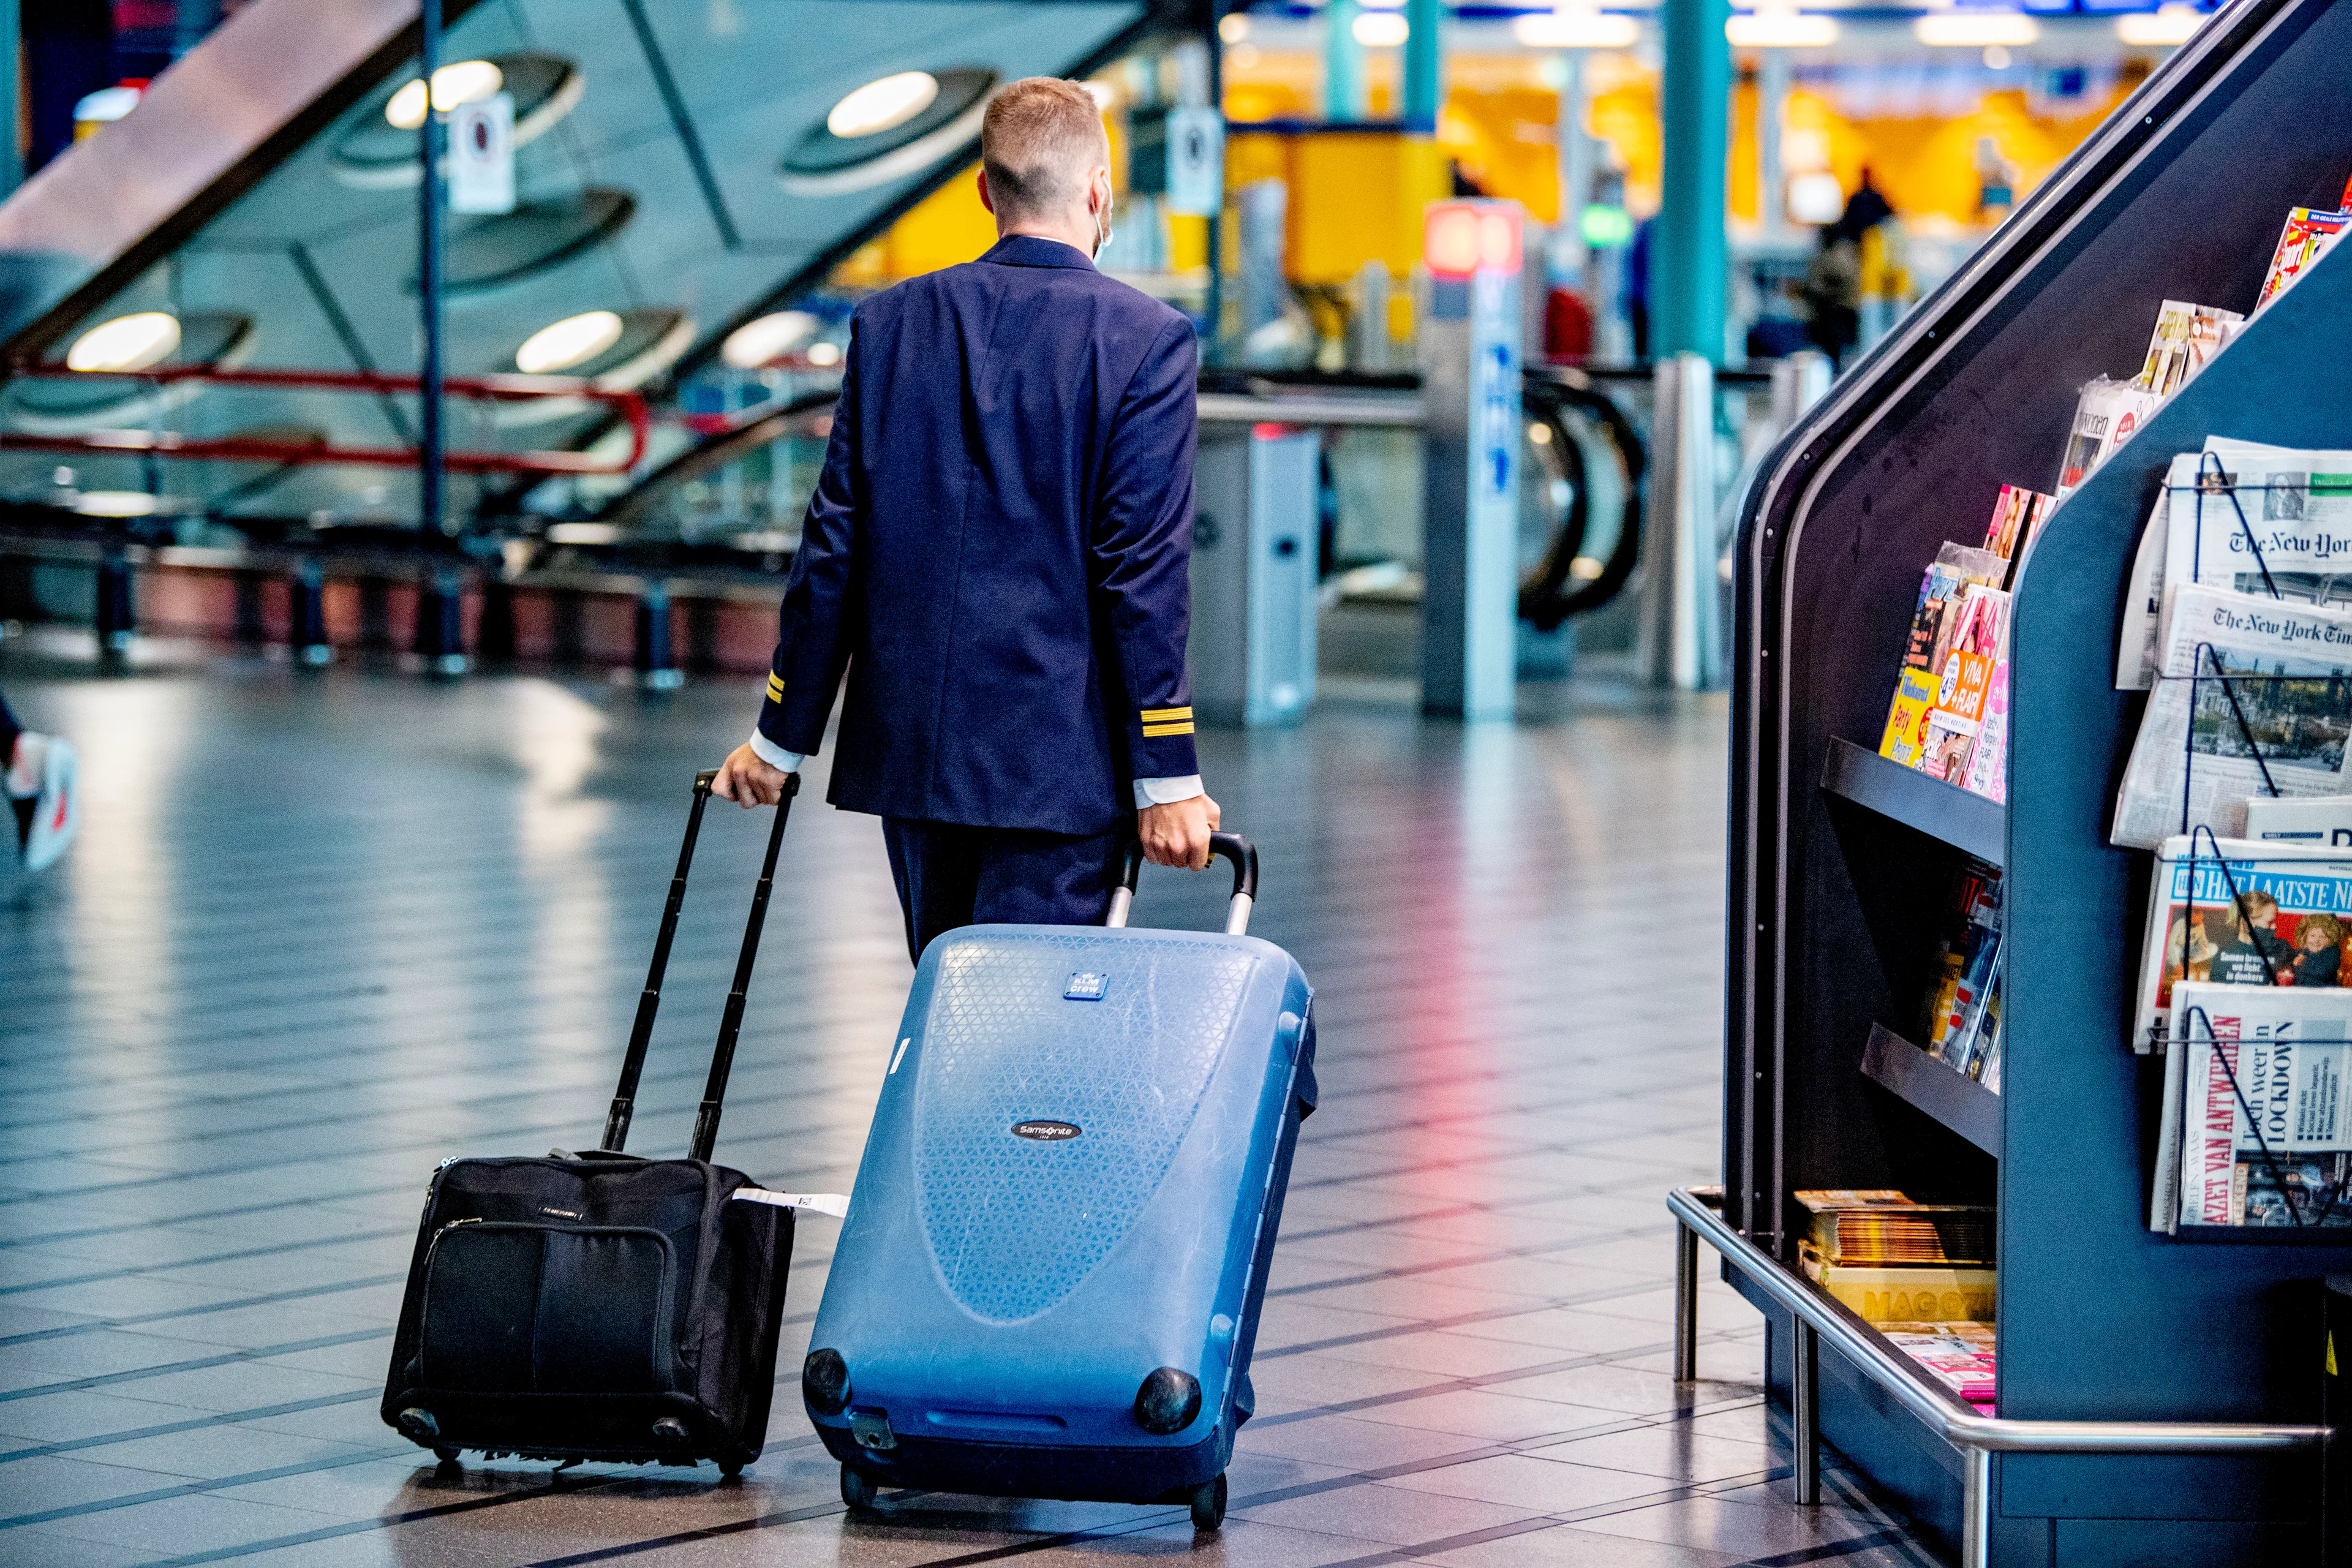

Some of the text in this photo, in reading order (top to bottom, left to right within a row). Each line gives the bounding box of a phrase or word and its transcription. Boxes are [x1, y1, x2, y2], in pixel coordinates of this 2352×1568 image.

[2269, 532, 2310, 553] New
[2315, 533, 2352, 559] Yor
[2213, 607, 2352, 645] The New York Tim
[1964, 659, 1983, 687] VIVA
[2252, 1048, 2267, 1092] weer
[2267, 1020, 2294, 1144] LOCKDOWN
[1020, 1126, 1072, 1136] Samsonite
[2242, 1100, 2264, 1144] Toch
[2205, 1137, 2232, 1174] VAN
